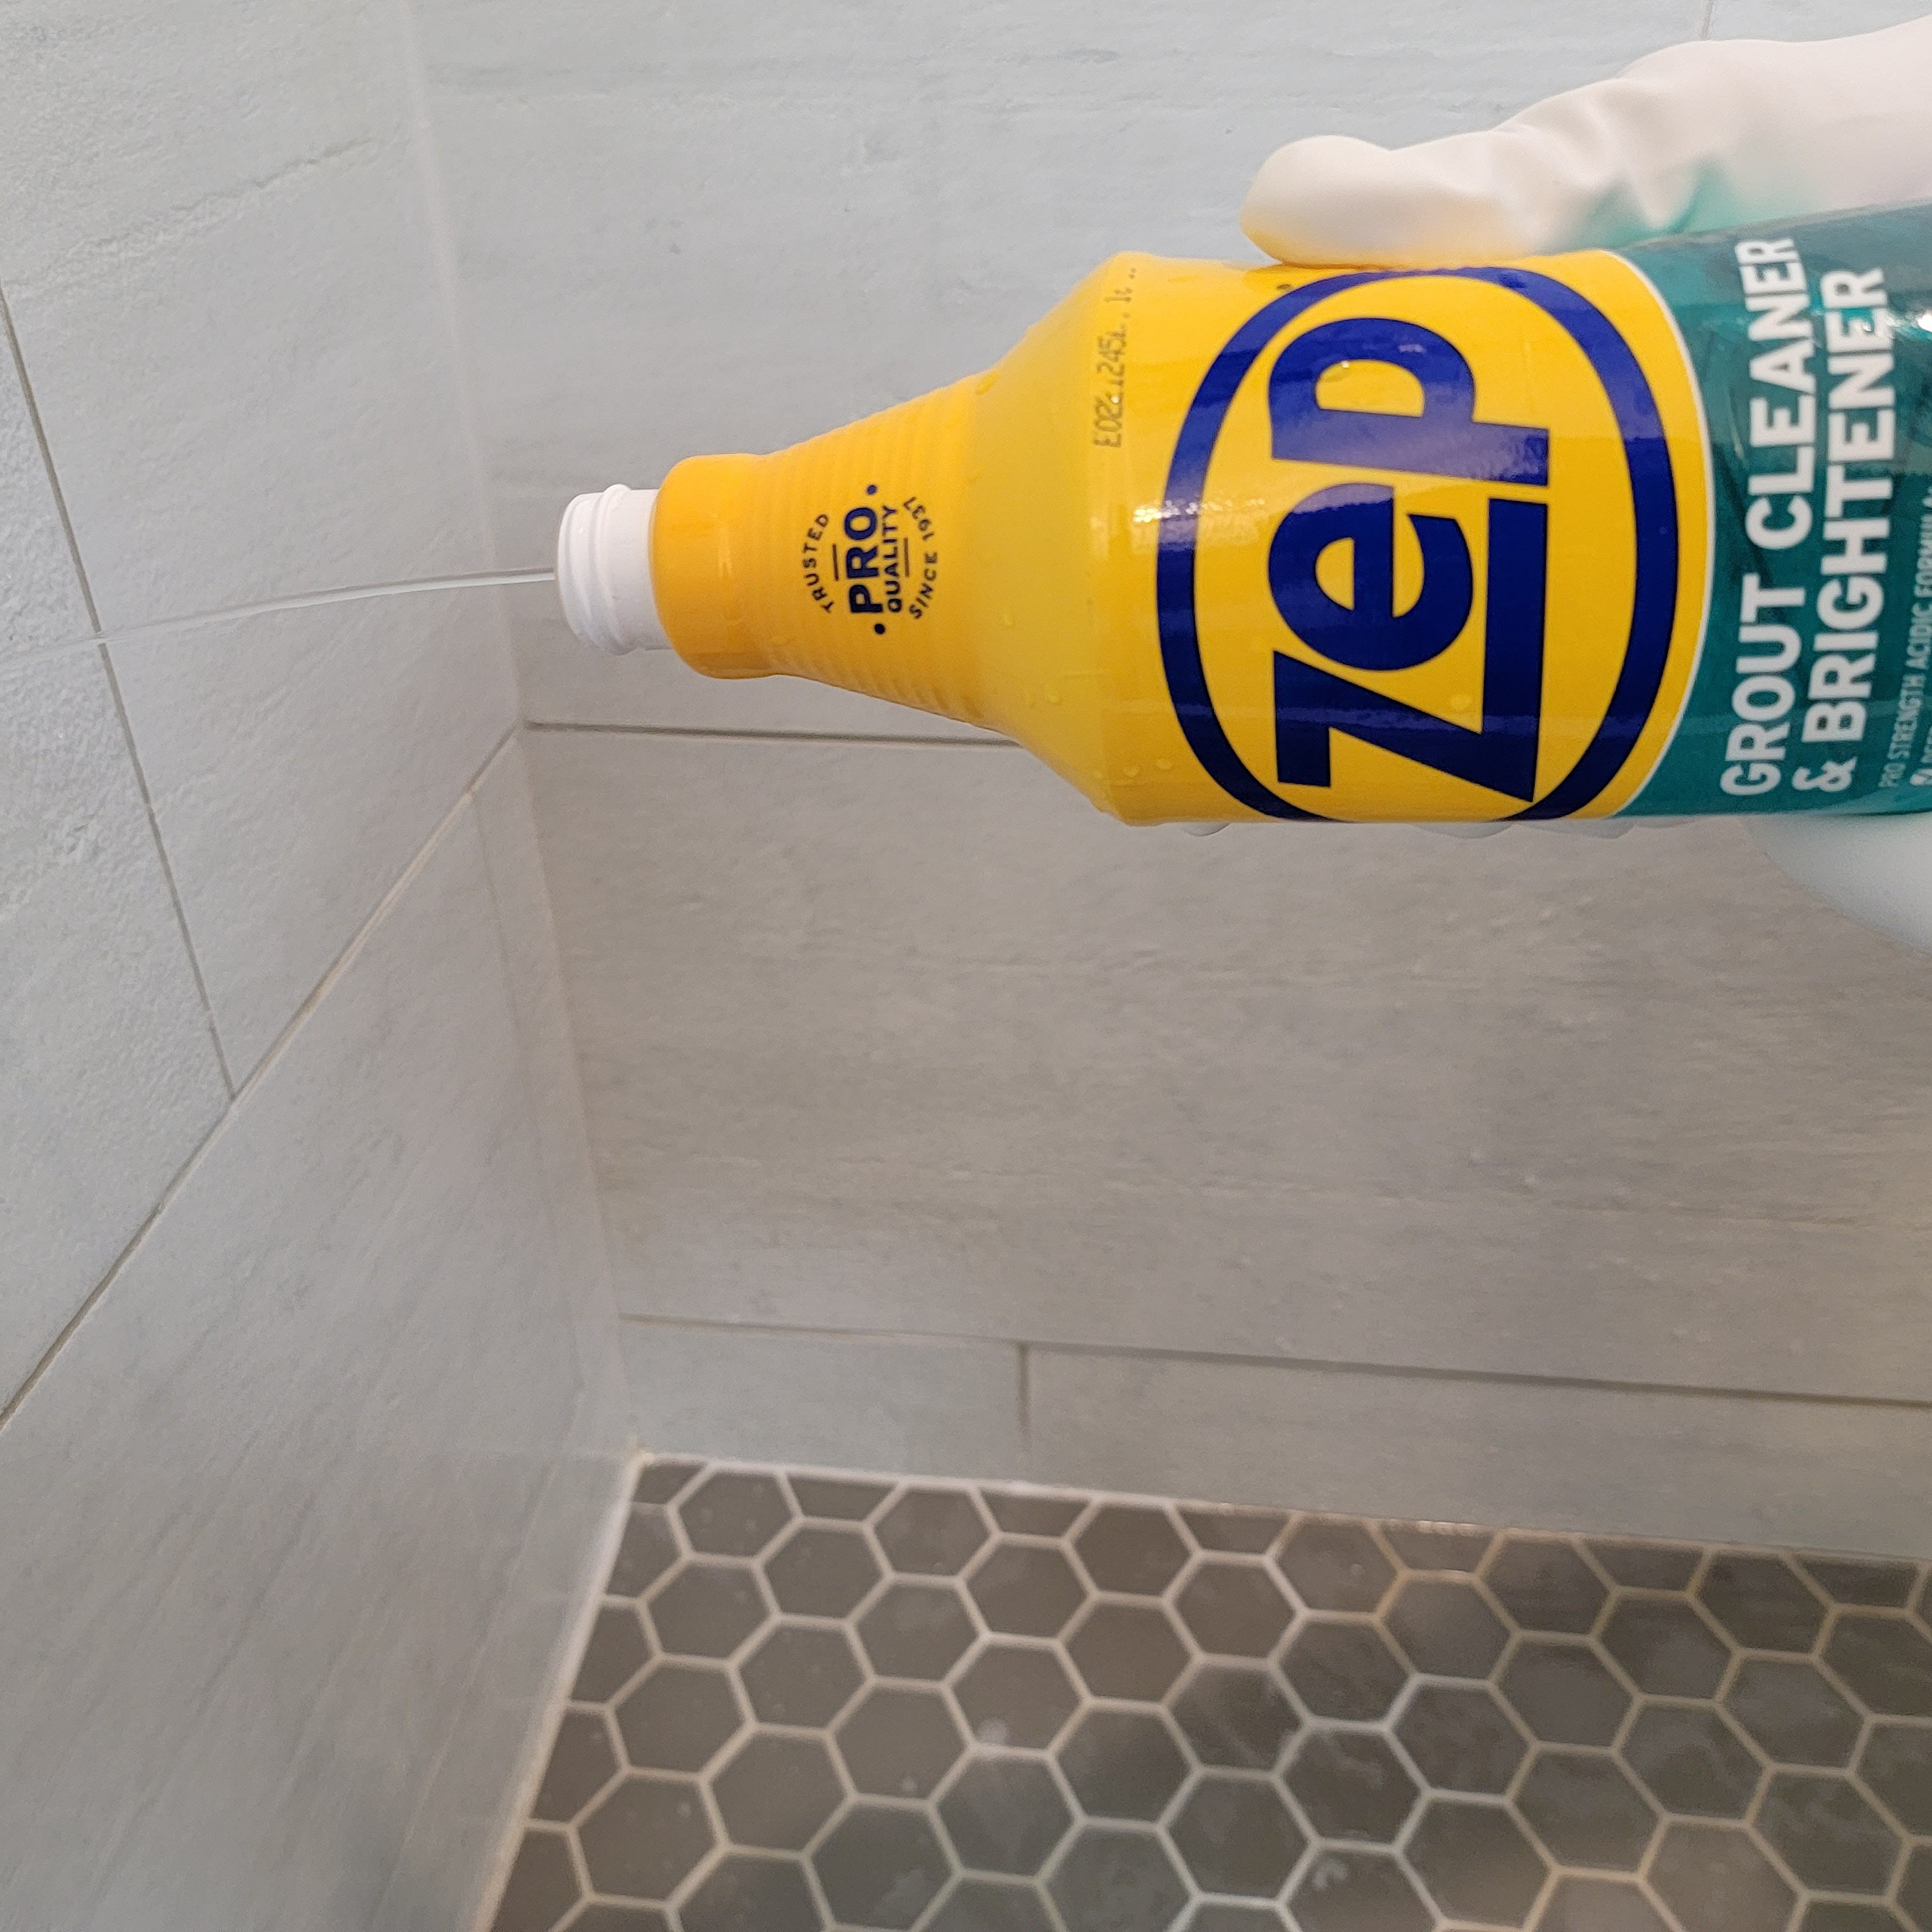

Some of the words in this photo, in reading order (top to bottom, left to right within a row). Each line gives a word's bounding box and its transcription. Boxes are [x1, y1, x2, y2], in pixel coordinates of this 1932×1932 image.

[1734, 238, 1817, 550] CLEANER
[903, 496, 934, 544] 1937
[1800, 267, 1896, 743] BRIGHTENER
[802, 513, 834, 613] TRUSTED
[844, 507, 883, 613] PRO
[882, 505, 902, 612] QUALITY
[909, 551, 938, 619] SINCE
[1906, 601, 1932, 671] ACIDIC
[1720, 572, 1805, 795] GROUT
[1887, 672, 1927, 761] STRENGTH
[1791, 755, 1858, 792] &
[1878, 761, 1906, 788] PRO
